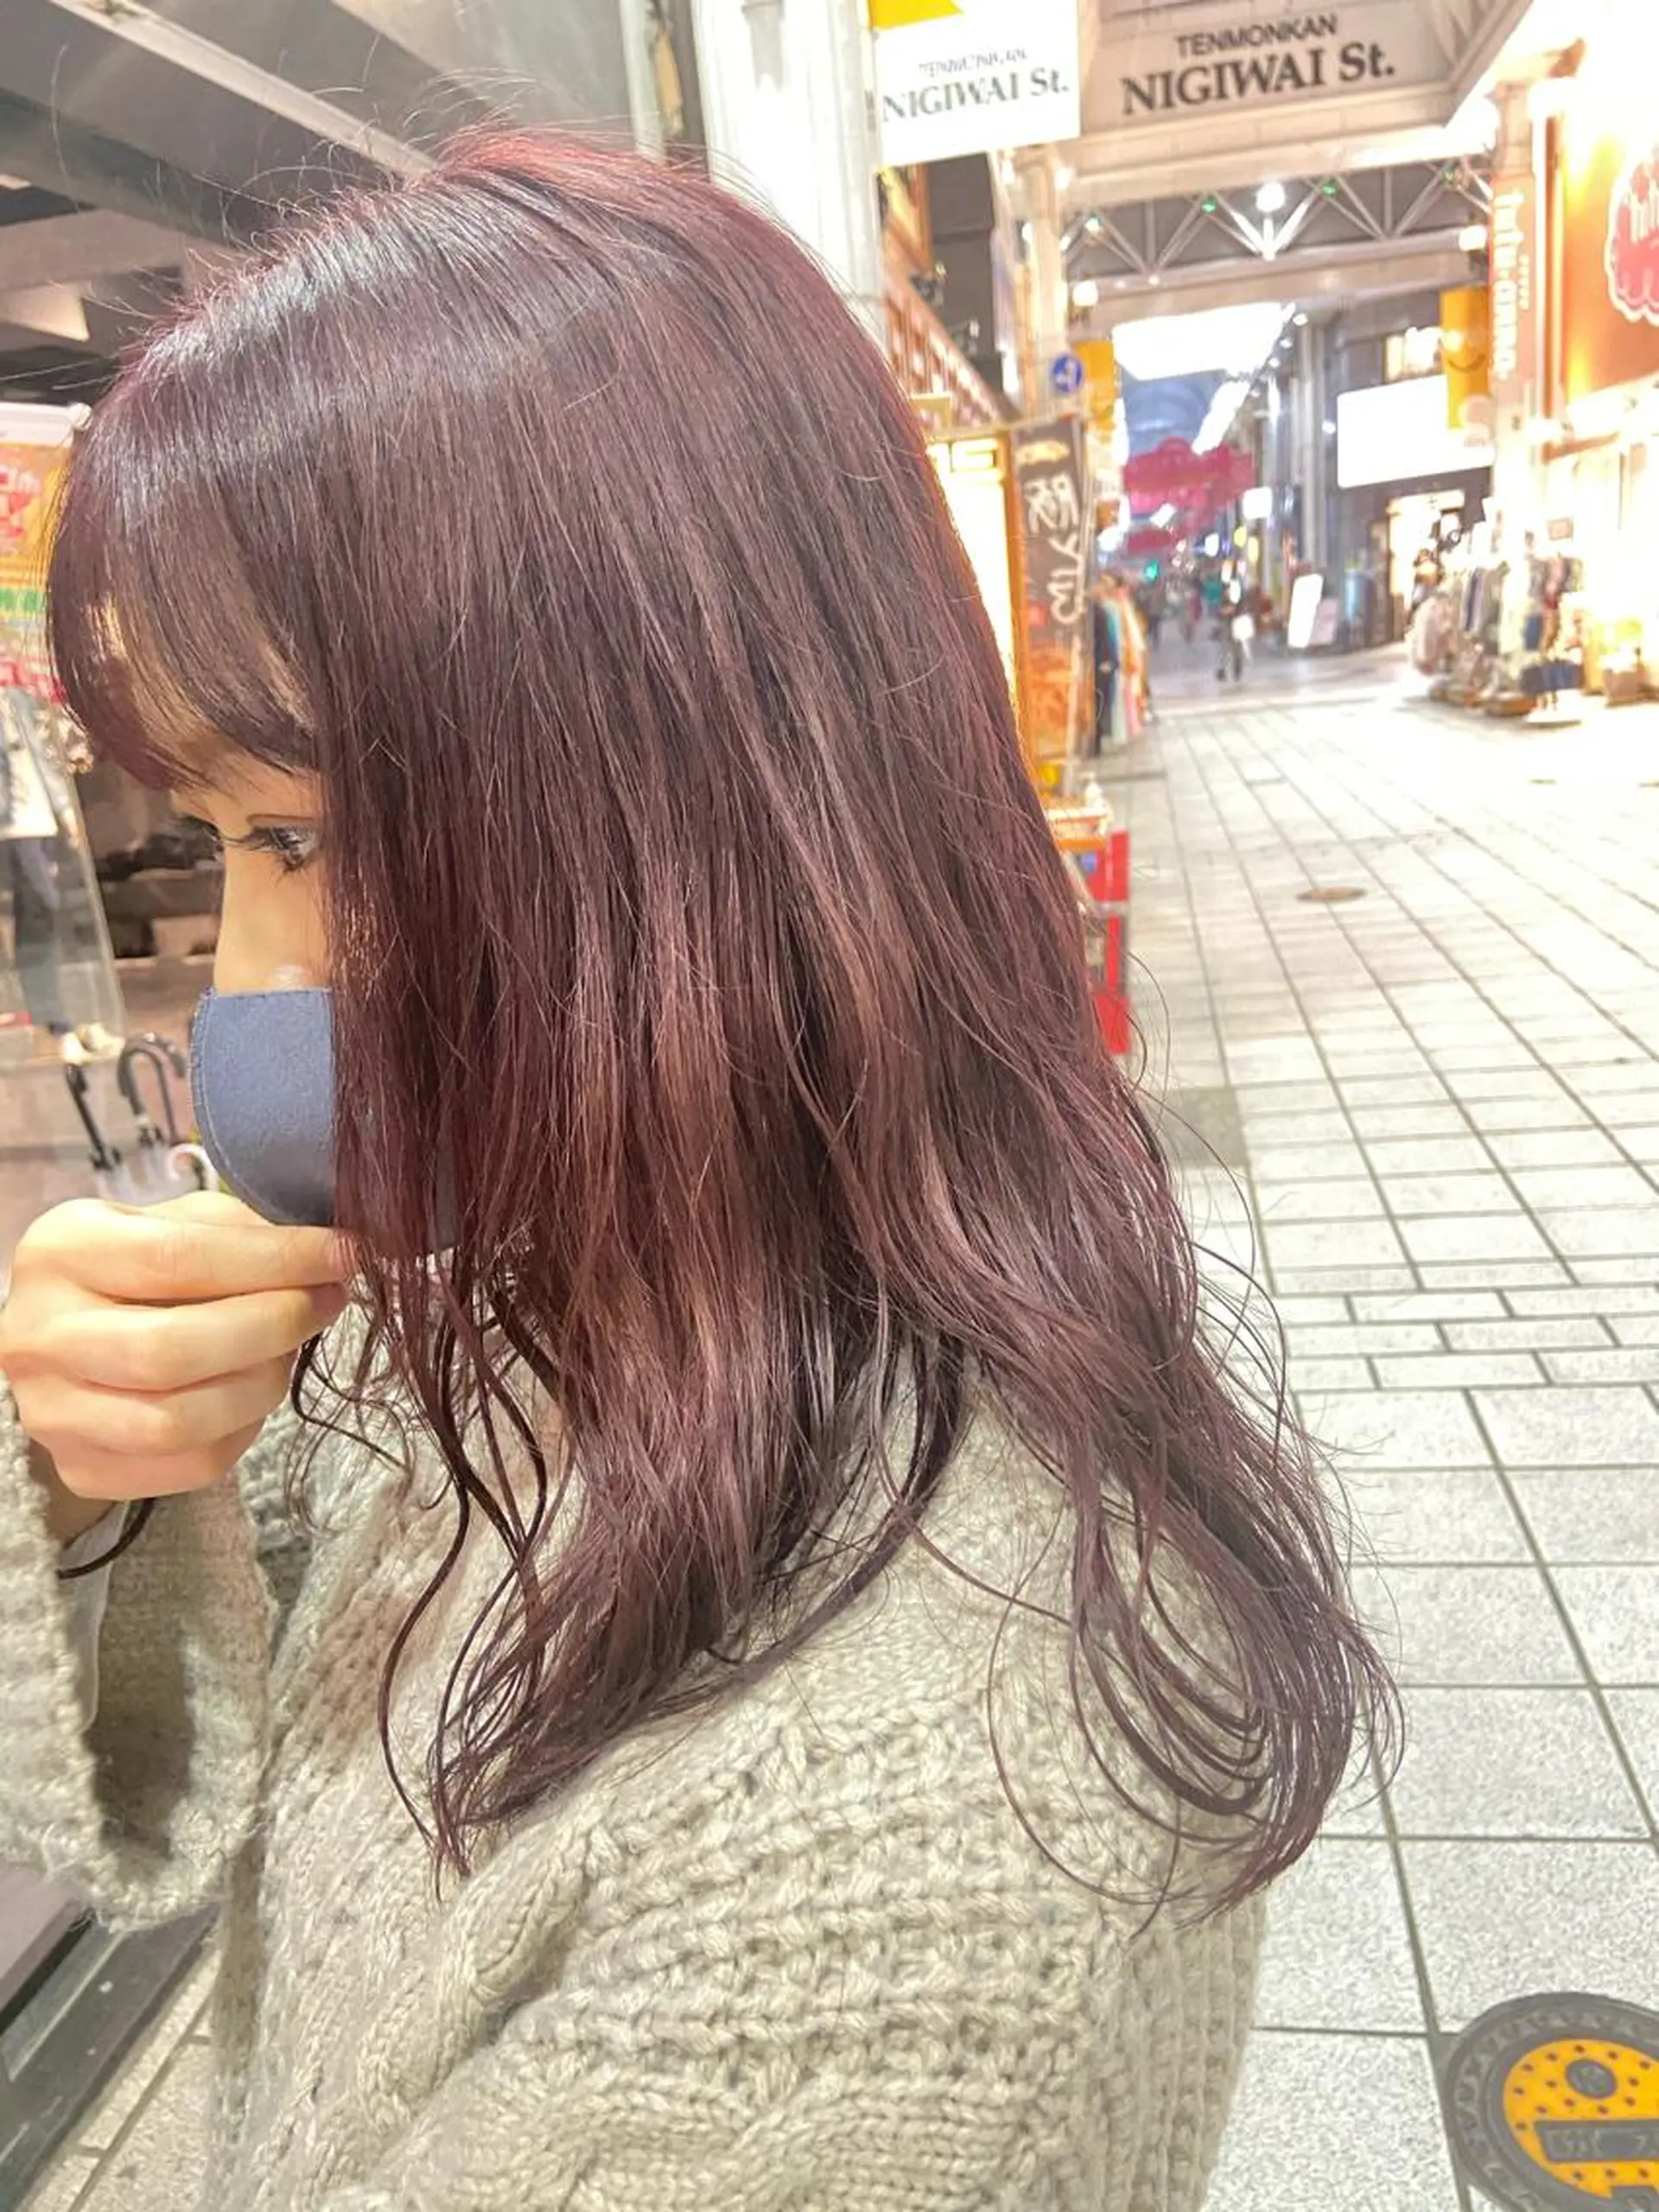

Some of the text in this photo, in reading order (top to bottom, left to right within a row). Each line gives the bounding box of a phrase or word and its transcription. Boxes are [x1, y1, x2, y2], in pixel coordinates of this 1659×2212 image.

[1177, 15, 1338, 59] TENMONKAN
[882, 67, 1069, 123] NIGIWAI St.
[1122, 41, 1395, 116] NIGIWAI St.
